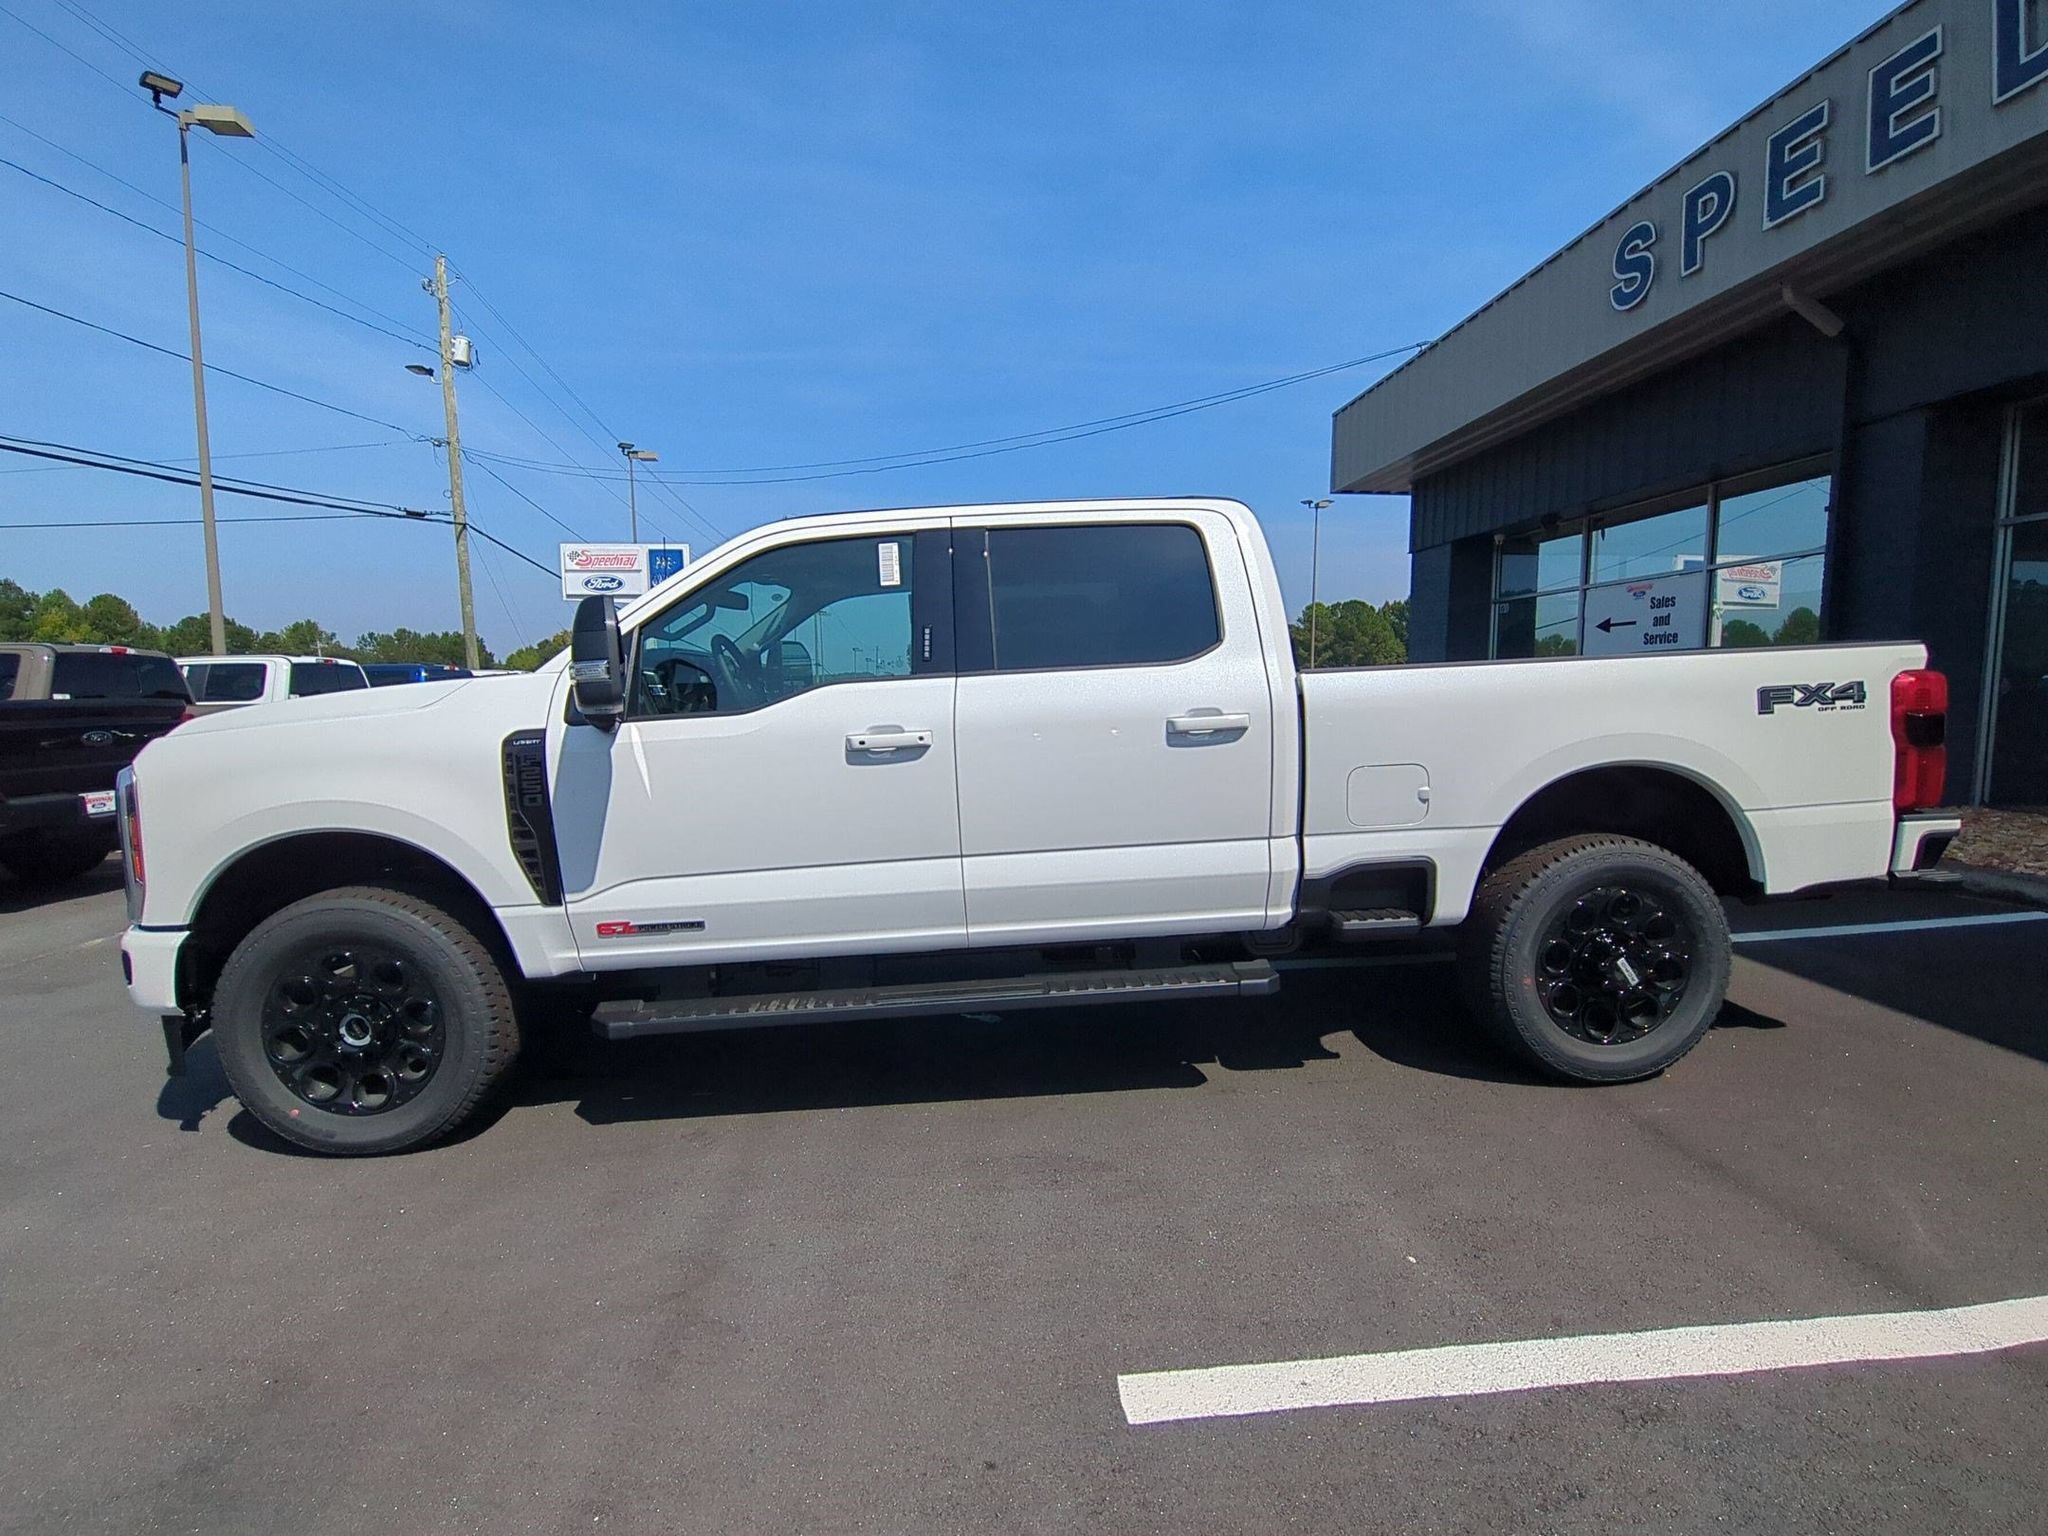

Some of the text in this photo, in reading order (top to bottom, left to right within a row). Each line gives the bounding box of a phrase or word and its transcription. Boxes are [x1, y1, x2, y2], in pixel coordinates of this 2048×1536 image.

[574, 549, 638, 569] Speedway
[586, 577, 620, 590] Ford
[1650, 595, 1677, 610] Sales
[1652, 612, 1671, 627] and
[1643, 631, 1679, 646] Service
[1757, 680, 1866, 715] FX4
